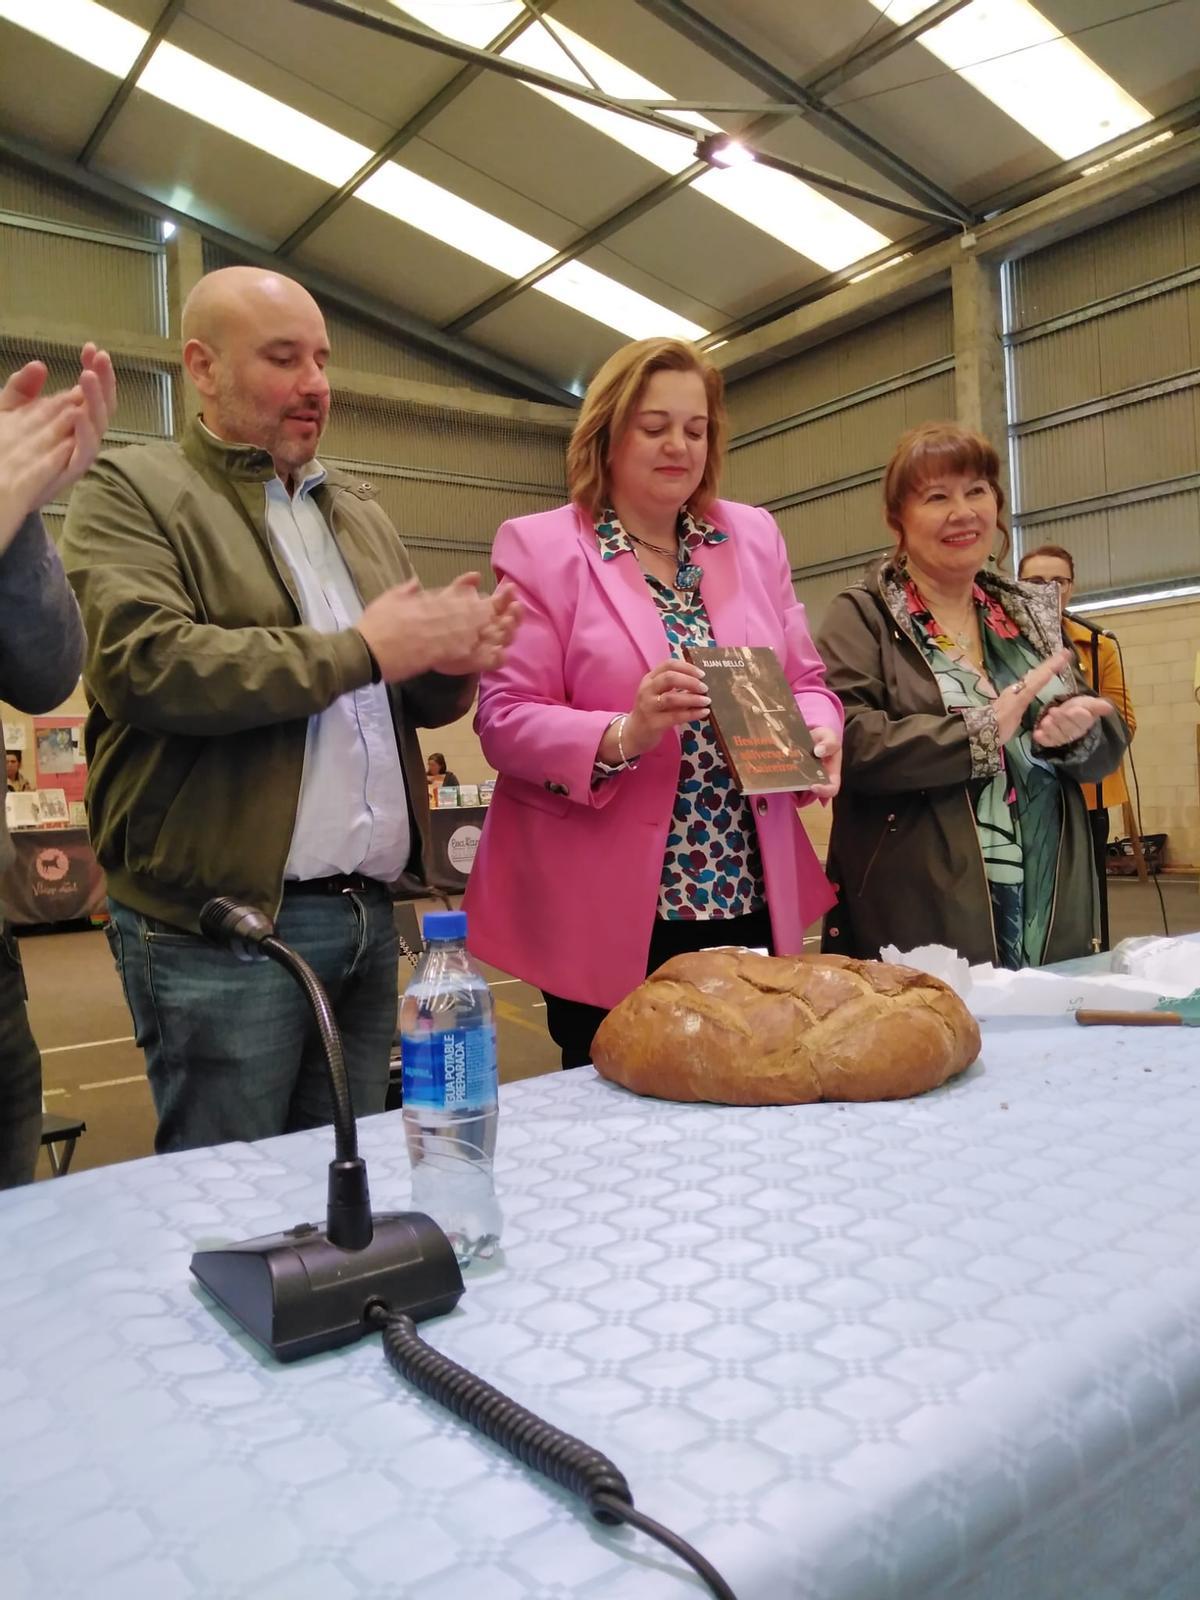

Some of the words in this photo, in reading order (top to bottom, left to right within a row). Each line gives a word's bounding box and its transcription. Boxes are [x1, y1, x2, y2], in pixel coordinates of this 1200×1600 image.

[702, 659, 722, 667] XUAN
[722, 659, 745, 668] BELLO
[444, 1033, 455, 1080] POTABLE
[454, 1041, 465, 1102] PREPARADA
[445, 1081, 456, 1104] GUA
